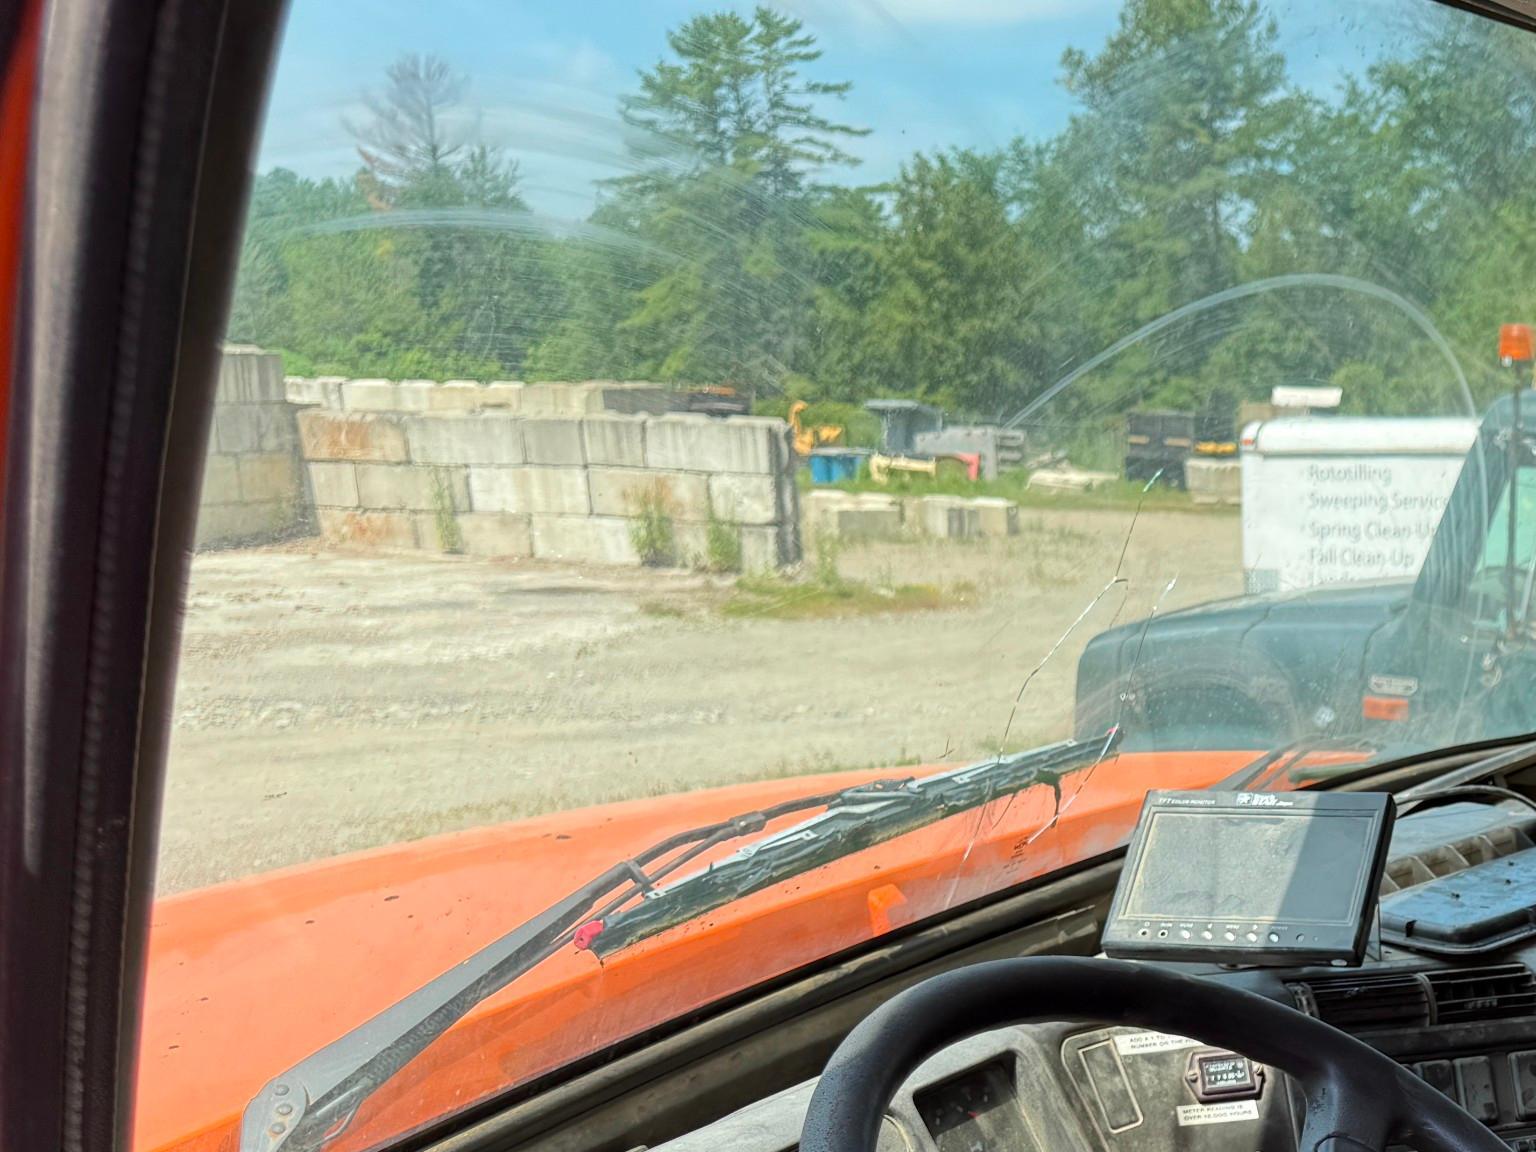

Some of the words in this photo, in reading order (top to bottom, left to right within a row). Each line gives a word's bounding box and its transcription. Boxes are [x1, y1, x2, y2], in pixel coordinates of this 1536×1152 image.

[1308, 464, 1392, 486] Rototilling
[1309, 491, 1388, 513] Sweeping
[1310, 522, 1361, 543] Spring
[1310, 547, 1337, 566] Fall
